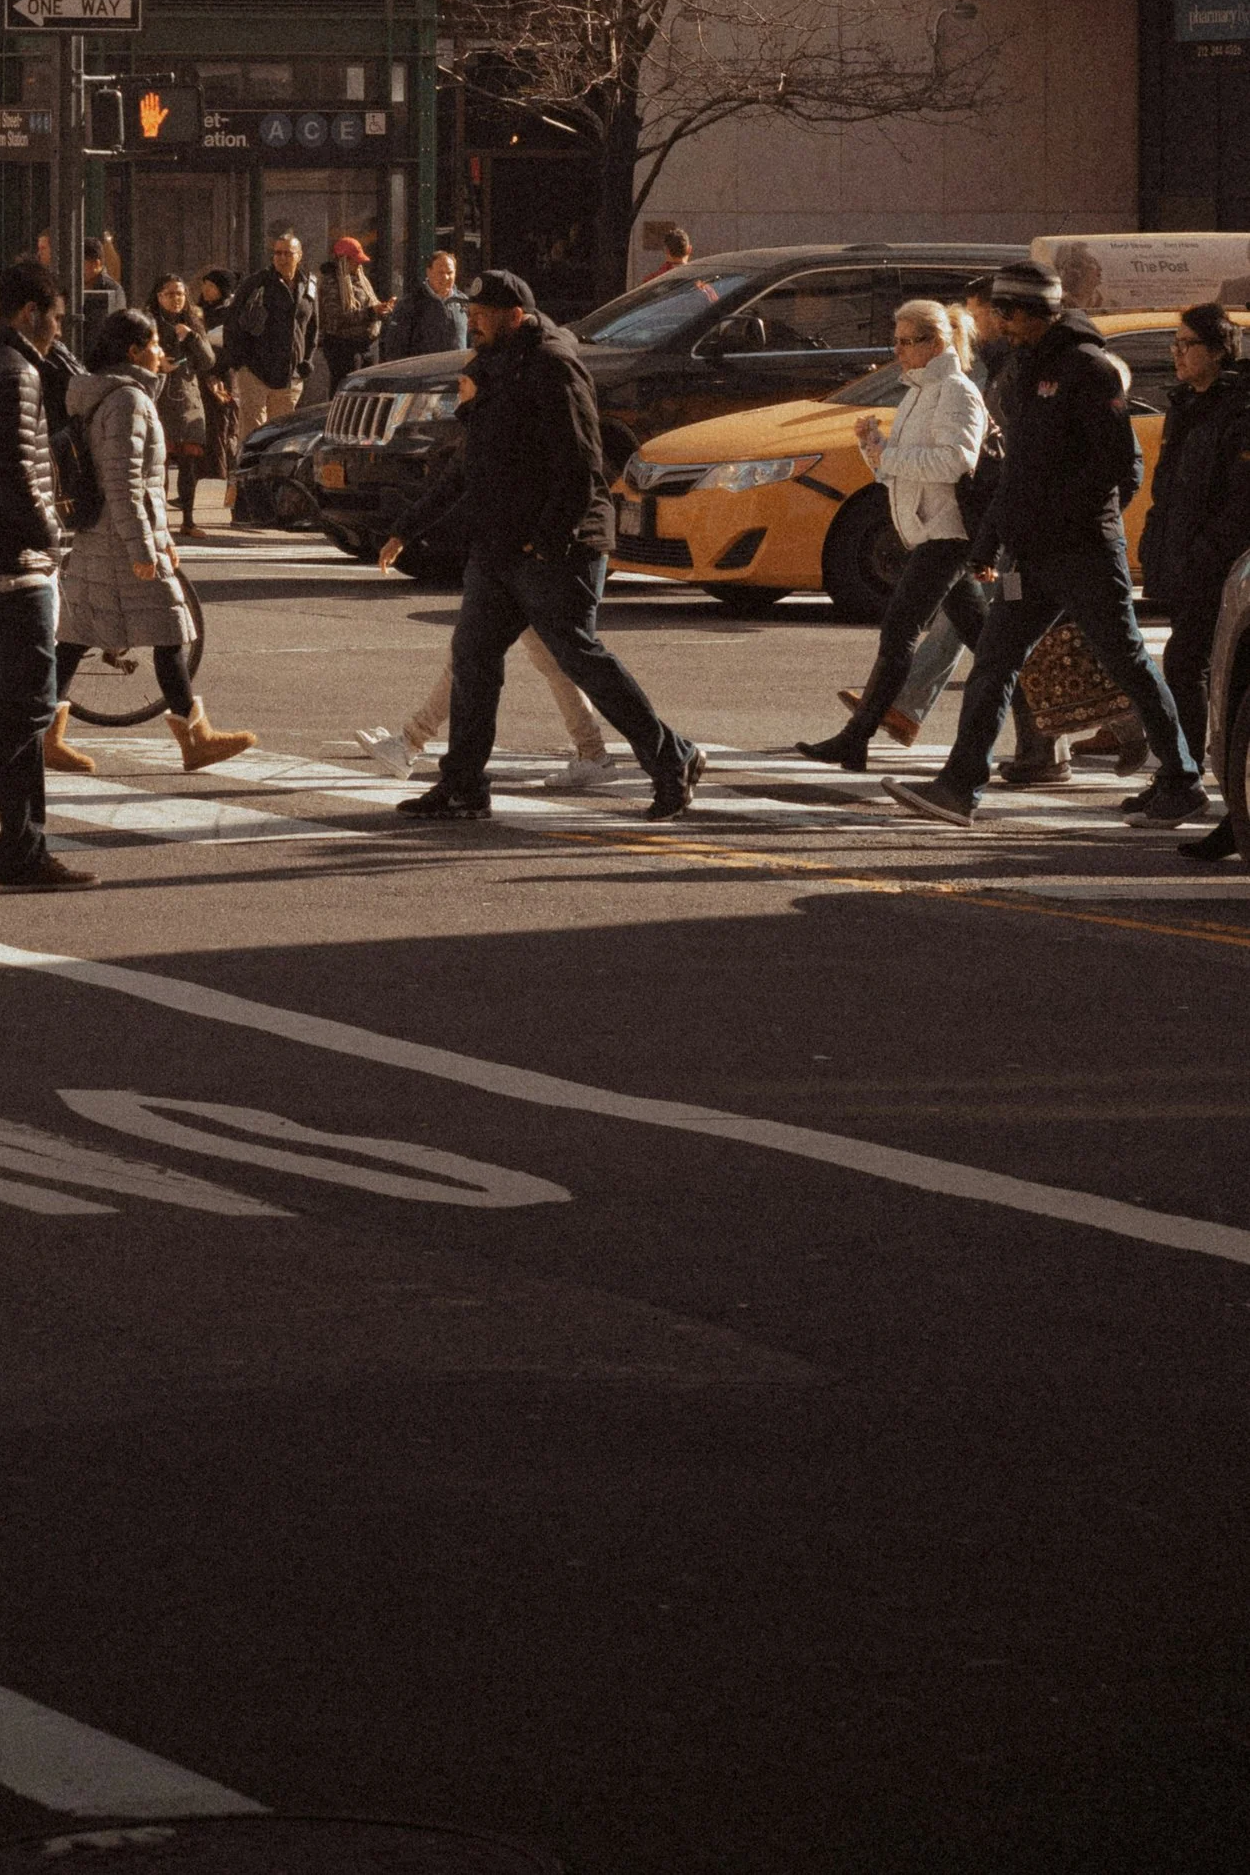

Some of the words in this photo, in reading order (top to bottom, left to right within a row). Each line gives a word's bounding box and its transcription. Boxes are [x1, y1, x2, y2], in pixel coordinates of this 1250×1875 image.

[268, 121, 285, 140] A
[304, 121, 320, 140] C
[340, 121, 354, 140] E
[203, 132, 248, 147] ation
[1131, 260, 1157, 273] The
[1158, 260, 1190, 273] Post
